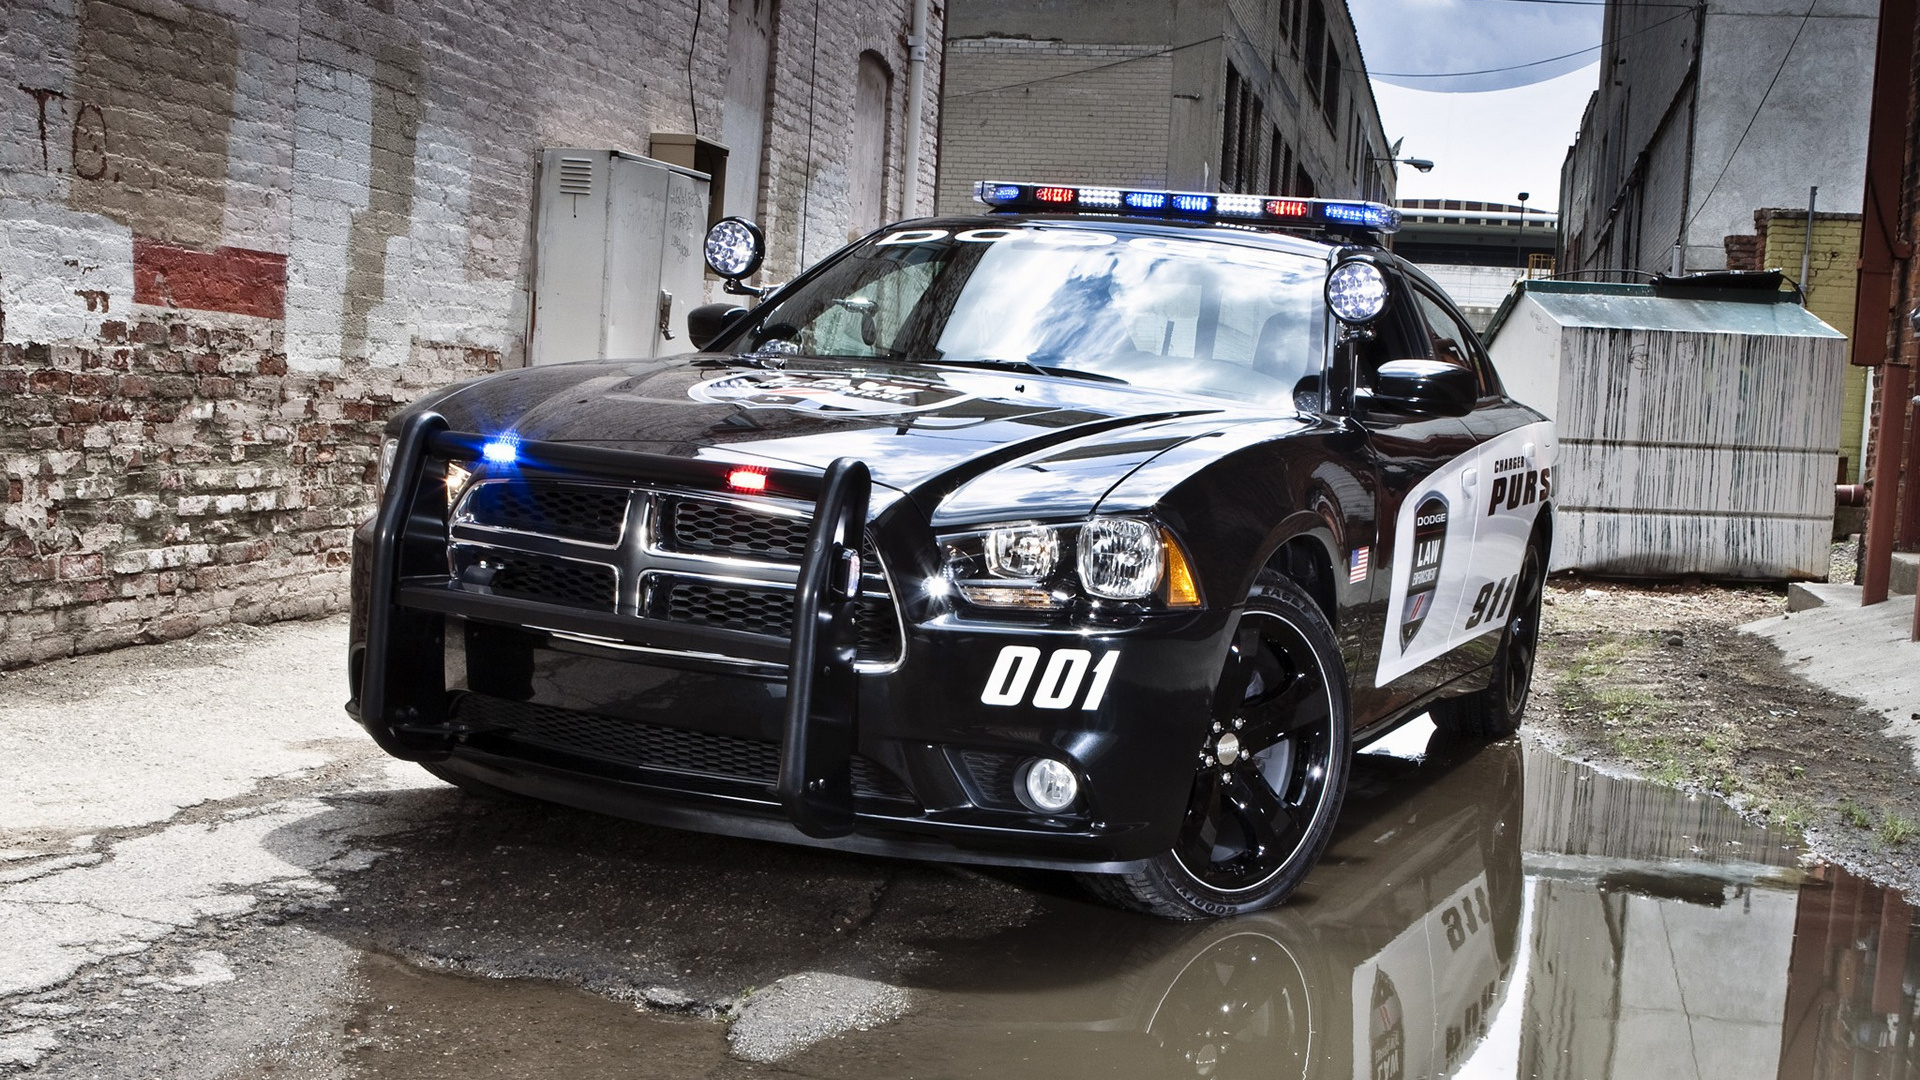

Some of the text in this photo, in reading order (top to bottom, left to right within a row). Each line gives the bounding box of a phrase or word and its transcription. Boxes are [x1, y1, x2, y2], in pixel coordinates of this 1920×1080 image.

[1494, 456, 1525, 474] CHARGER
[1417, 513, 1447, 527] DODGE
[1417, 539, 1441, 568] LAW
[1465, 573, 1519, 631] 911
[980, 645, 1121, 711] 001
